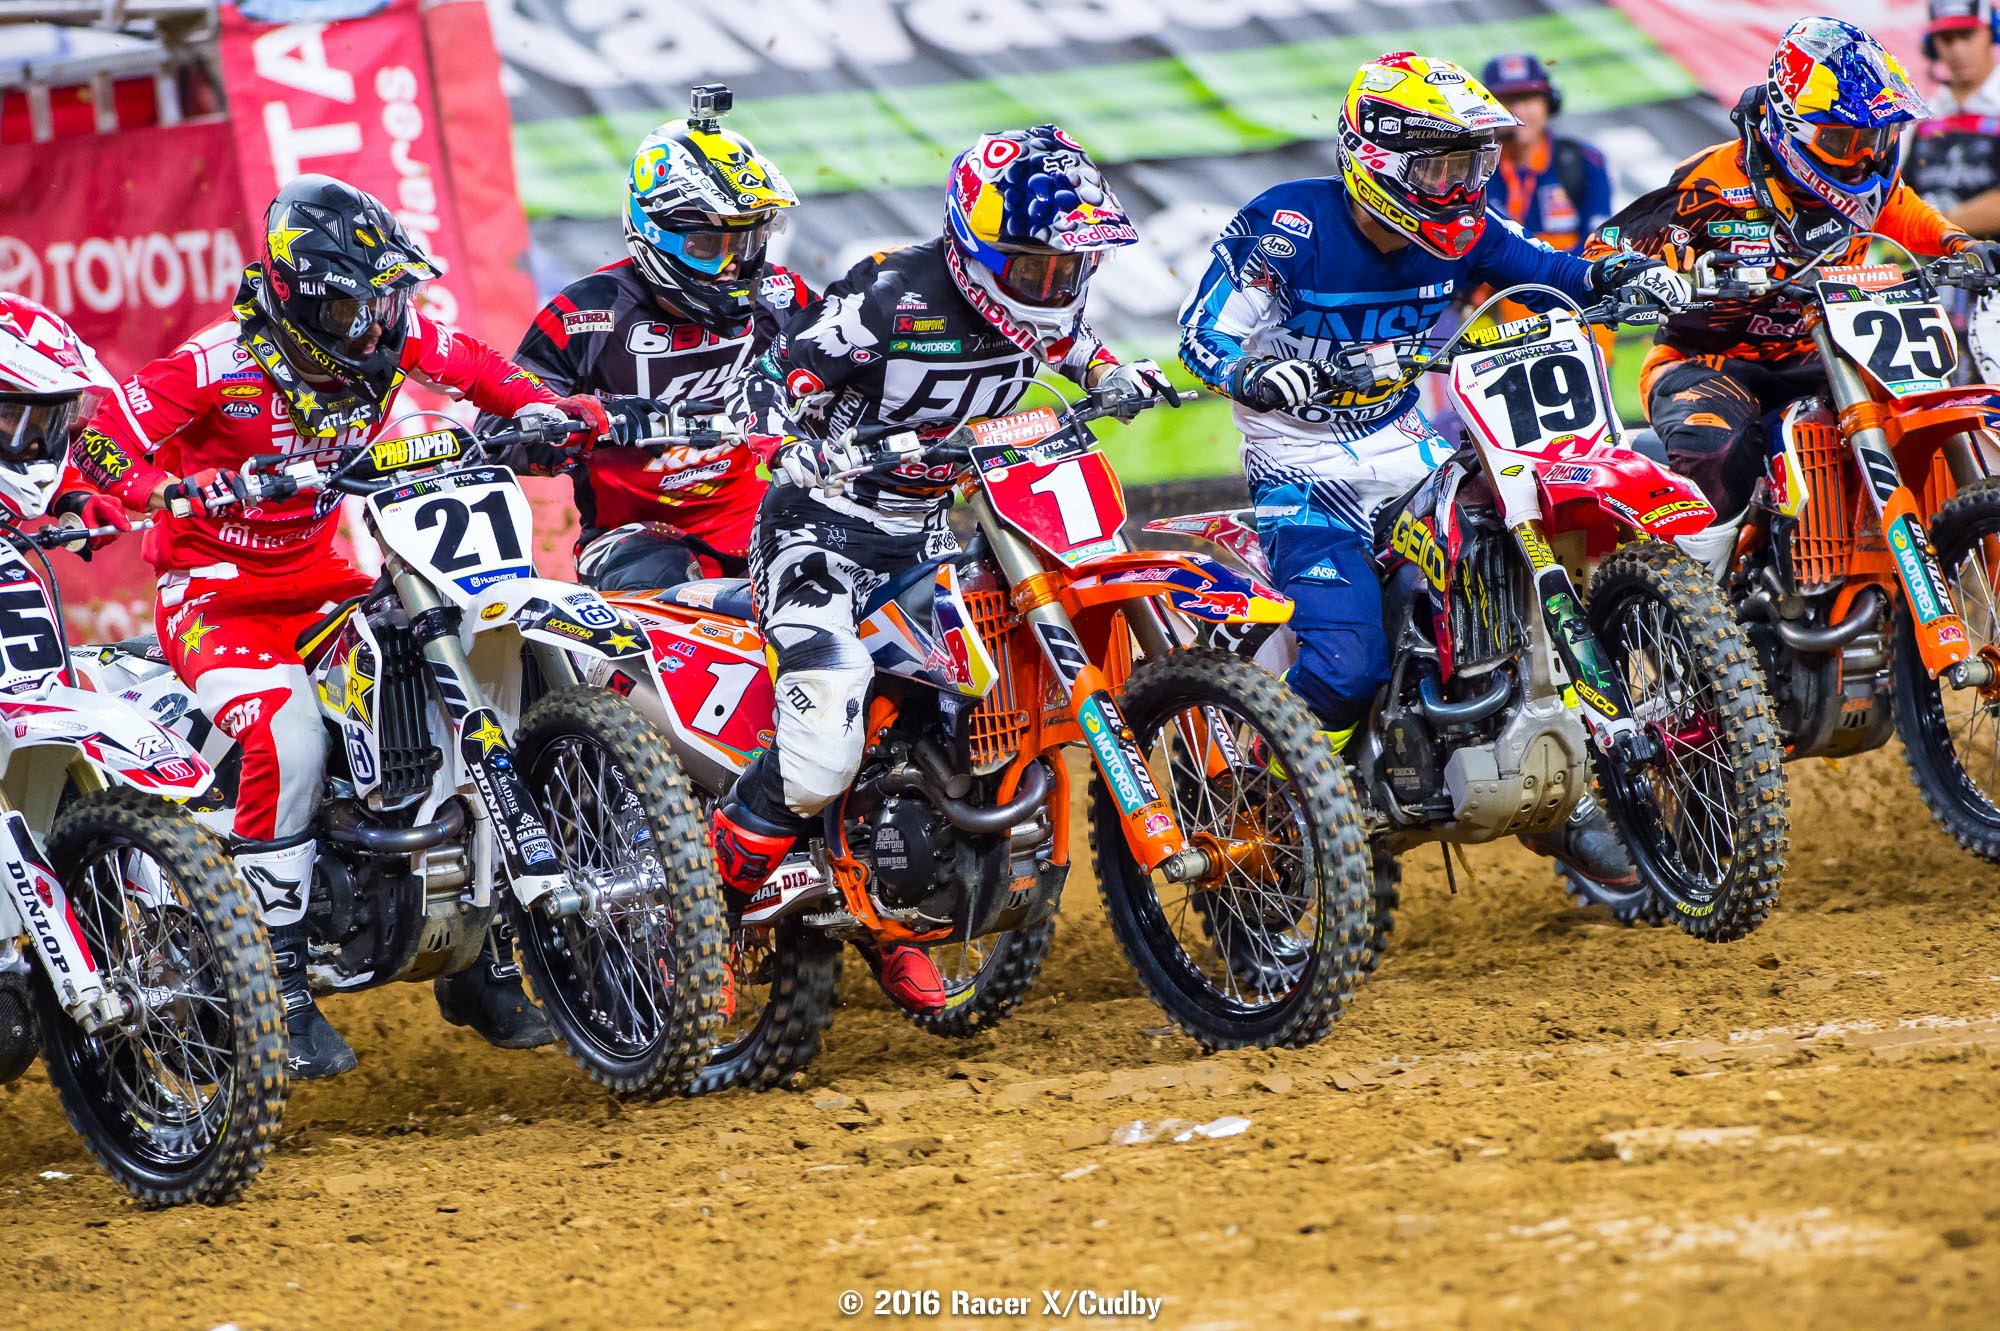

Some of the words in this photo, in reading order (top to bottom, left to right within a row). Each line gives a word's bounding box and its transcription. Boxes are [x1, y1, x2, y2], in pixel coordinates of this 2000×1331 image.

[1722, 187, 1754, 197] PAR
[1813, 177, 1860, 218] Bull
[1357, 179, 1420, 233] GEICO
[1278, 213, 1308, 233] 100%
[1734, 223, 1770, 238] MOTO
[1061, 226, 1102, 248] Red
[1099, 223, 1138, 242] Bull
[1263, 236, 1292, 254] Arai
[47, 229, 244, 316] TOYOTA
[763, 275, 793, 289] AMA
[1828, 270, 1898, 284] RENTHAL
[896, 303, 929, 311] RENTHAL
[946, 246, 987, 310] Red
[982, 299, 1039, 351] Bull
[566, 311, 612, 326] BUBBA
[910, 341, 956, 354] MOTOREX
[1505, 344, 1554, 361] MONSTER
[1853, 307, 1957, 383] 25
[221, 372, 264, 380] PARTS
[124, 374, 154, 416] THOR
[221, 386, 263, 397] FMF
[1484, 354, 1597, 449] 19
[223, 401, 261, 414] Airoh
[318, 404, 373, 431] ATLAS
[977, 409, 1051, 434] RENTHAL
[984, 421, 1057, 446] RENTHAL
[1552, 435, 1575, 445] GEICO
[374, 431, 455, 466] PROTAPER
[662, 459, 731, 485] Palmetto
[1548, 465, 1595, 483] AMSOIL
[1030, 459, 1104, 547] 1
[1603, 495, 1640, 517] DUNLOP
[1640, 500, 1709, 525] GEICO
[1652, 510, 1711, 529] HONDA
[414, 490, 524, 574] 21
[1390, 510, 1447, 593] GEICO
[480, 571, 517, 585] Husqvarna
[1141, 566, 1179, 581] Bull
[1307, 565, 1339, 580] ANSR
[1899, 547, 1938, 620] MOTOREX
[481, 602, 509, 621] FMF
[546, 617, 594, 640] ROCKSTAR
[702, 625, 719, 637] 450
[668, 641, 698, 657] AMA
[690, 661, 761, 737] 1
[786, 684, 817, 716] FOX
[1575, 678, 1620, 717] GEICO
[1099, 700, 1160, 800] DULOP
[1093, 731, 1141, 811] MOTOREX
[470, 762, 518, 857] DUNLOP
[875, 839, 905, 850] FACTORY
[876, 829, 901, 841] KTM
[877, 856, 908, 865] HINSON
[781, 870, 808, 891] D.I.D
[1008, 876, 1037, 893] KTM
[6, 859, 70, 975] DUNLOP
